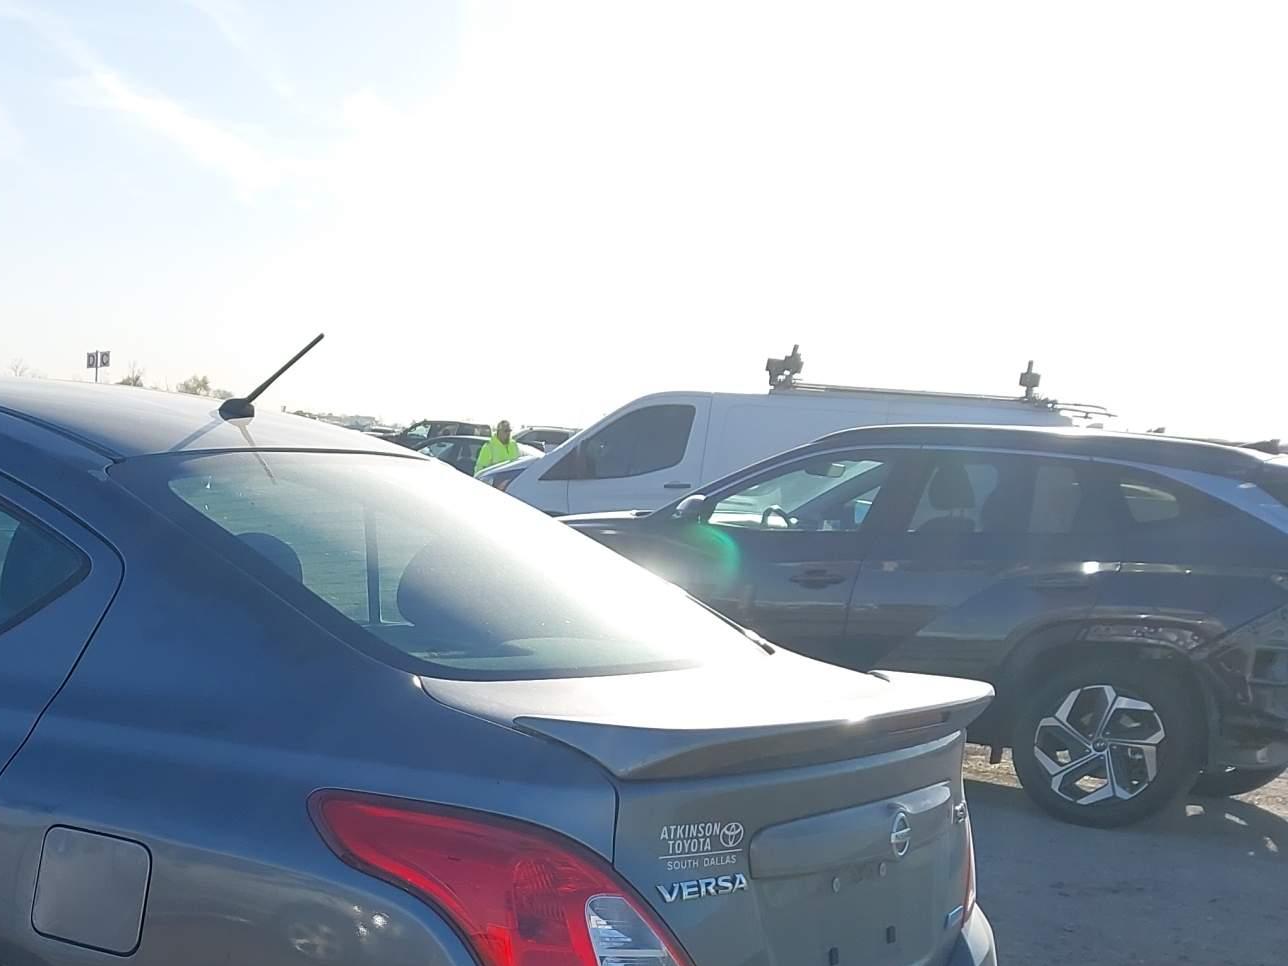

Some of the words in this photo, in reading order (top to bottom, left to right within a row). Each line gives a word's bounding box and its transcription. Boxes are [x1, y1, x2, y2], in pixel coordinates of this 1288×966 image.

[660, 822, 721, 840] ATKINSON
[667, 838, 711, 854] TOYOTA
[667, 859, 699, 871] SOUTH
[703, 854, 737, 867] DALLAS
[655, 873, 748, 903] VERSA
